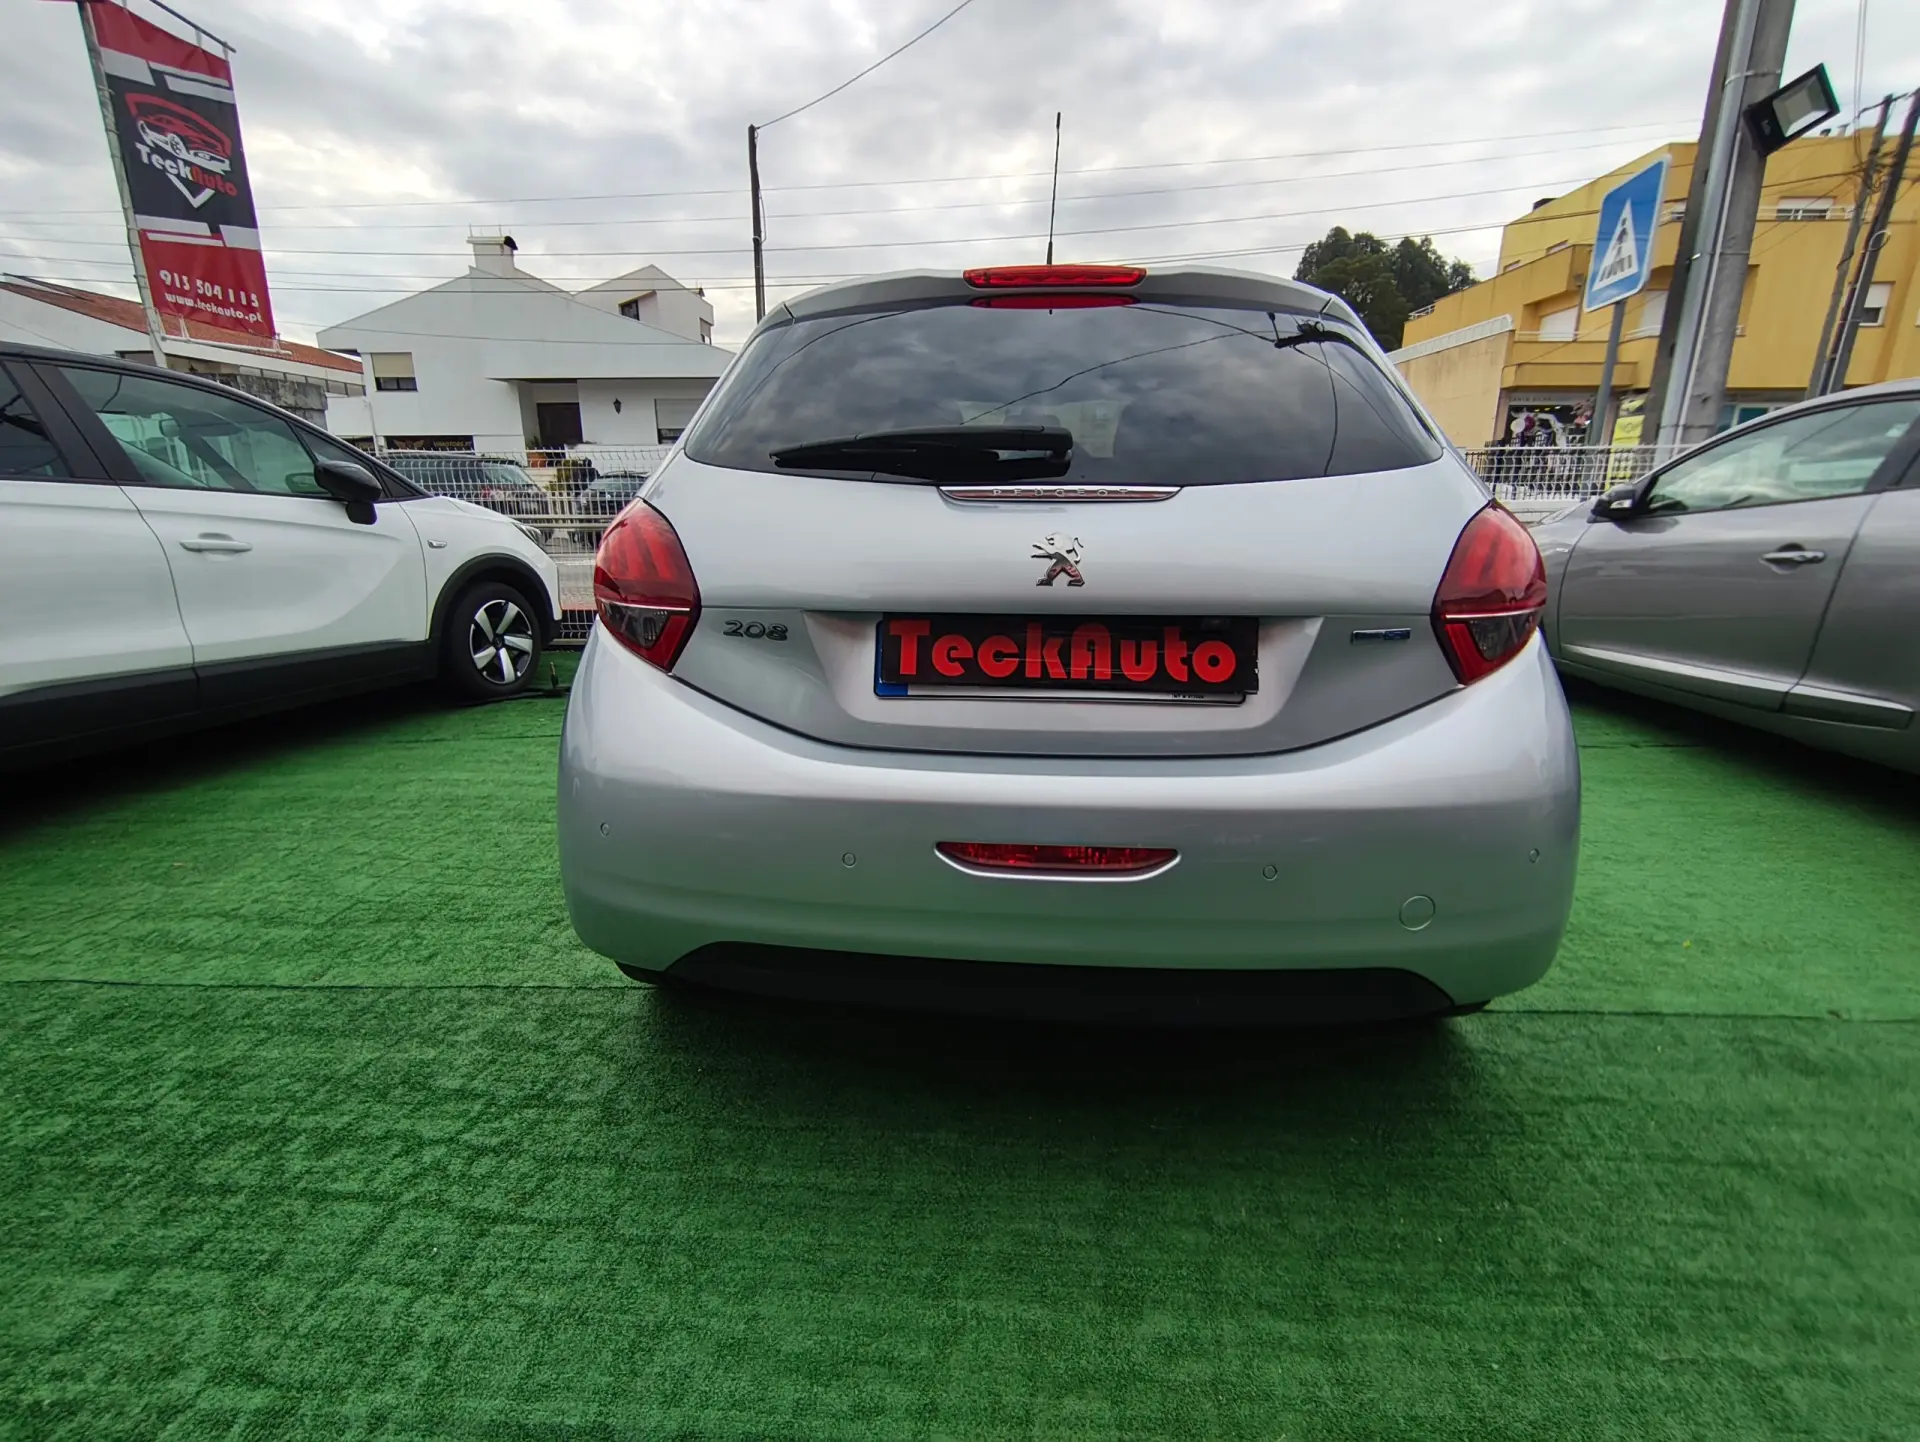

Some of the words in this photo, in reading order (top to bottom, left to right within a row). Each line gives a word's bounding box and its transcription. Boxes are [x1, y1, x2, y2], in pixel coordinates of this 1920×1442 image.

[135, 142, 238, 197] TeckAuto
[164, 292, 263, 323] www.teckauto.pt
[992, 488, 1128, 497] PEUGEOT
[722, 619, 789, 641] 208
[889, 619, 1237, 683] TeckAuto
